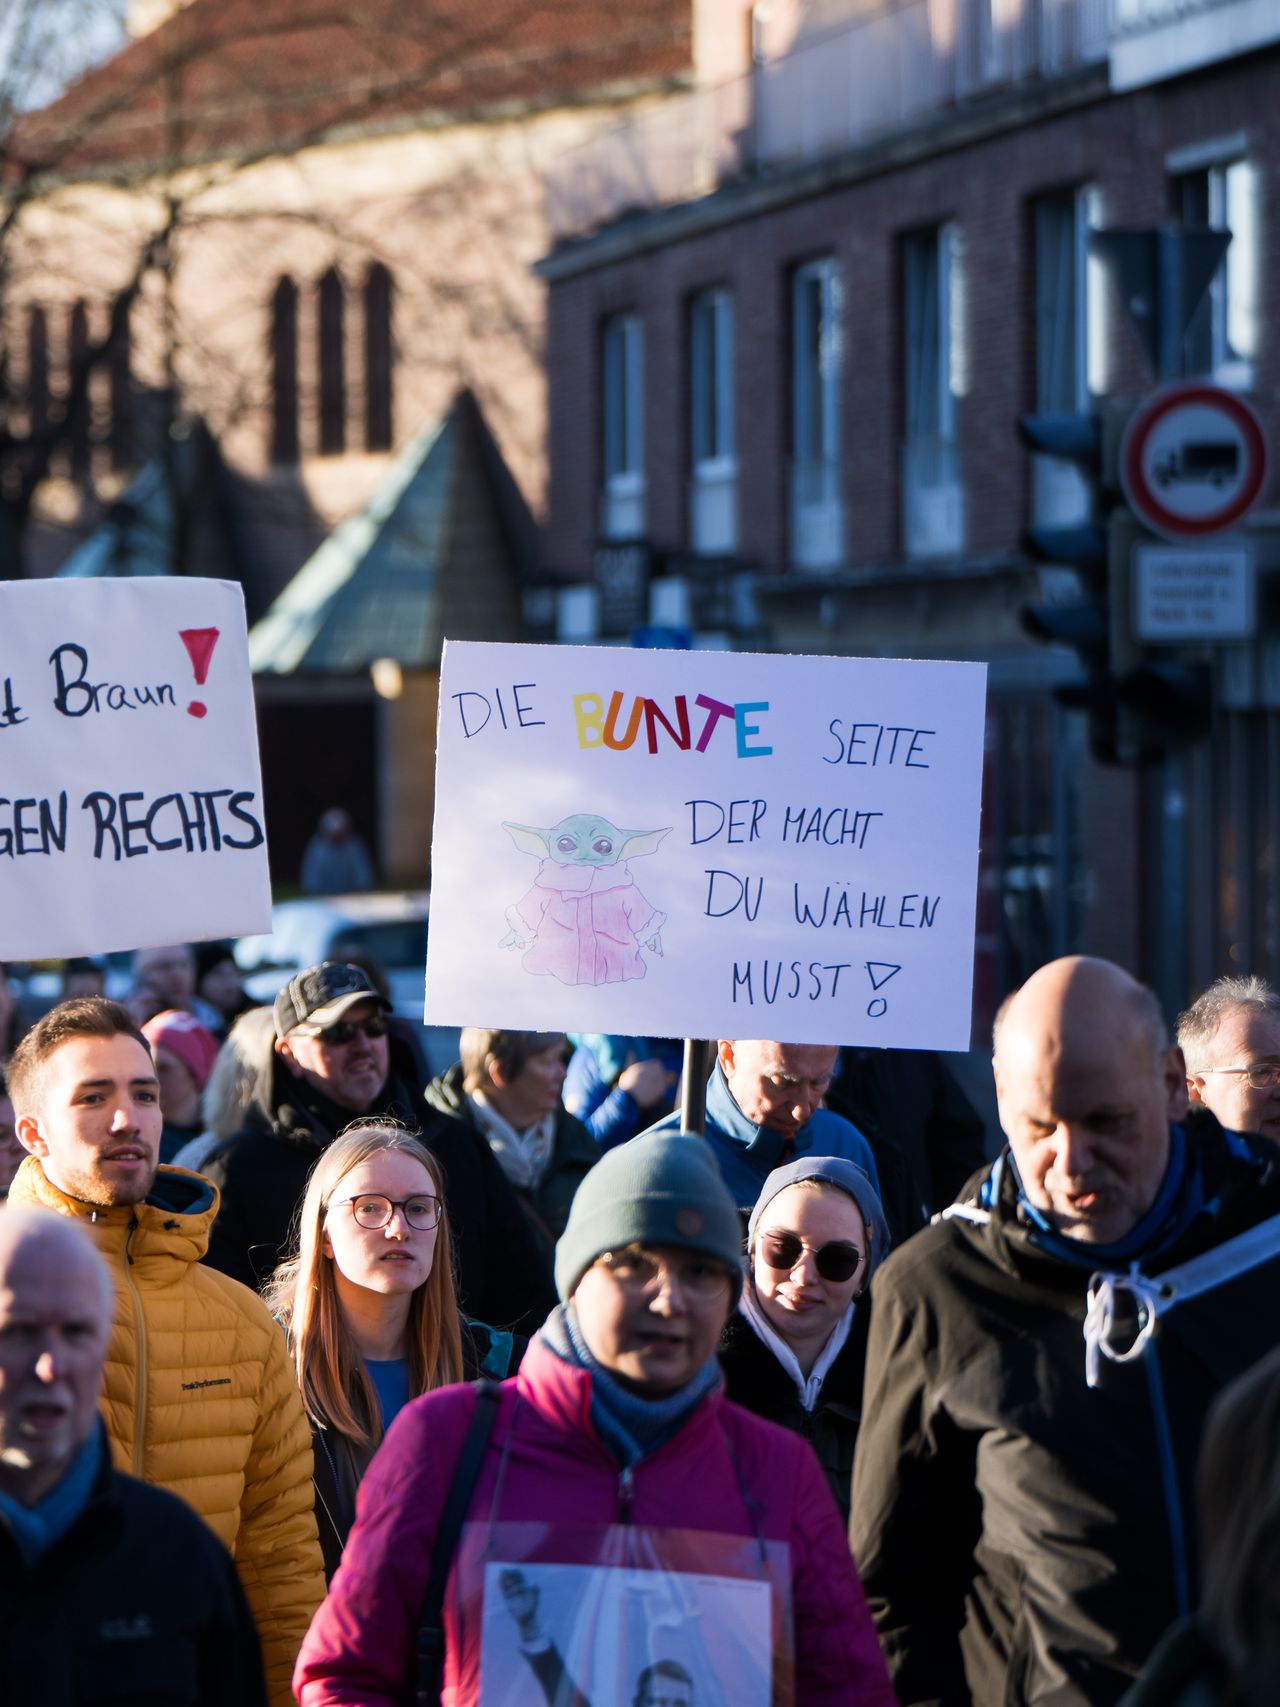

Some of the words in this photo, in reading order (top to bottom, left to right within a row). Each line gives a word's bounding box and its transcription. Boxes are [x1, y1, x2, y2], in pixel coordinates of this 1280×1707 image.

[49, 627, 221, 718] Braun!
[452, 684, 545, 738] DIE
[572, 690, 774, 759] BUNTE
[823, 719, 936, 769] SEITE
[82, 789, 265, 861] RECHTS
[685, 800, 767, 846] DER
[783, 806, 884, 850] MACHT
[704, 869, 764, 921] DU
[794, 881, 941, 929] WÄHLEN
[732, 960, 902, 1018] MUSST!
